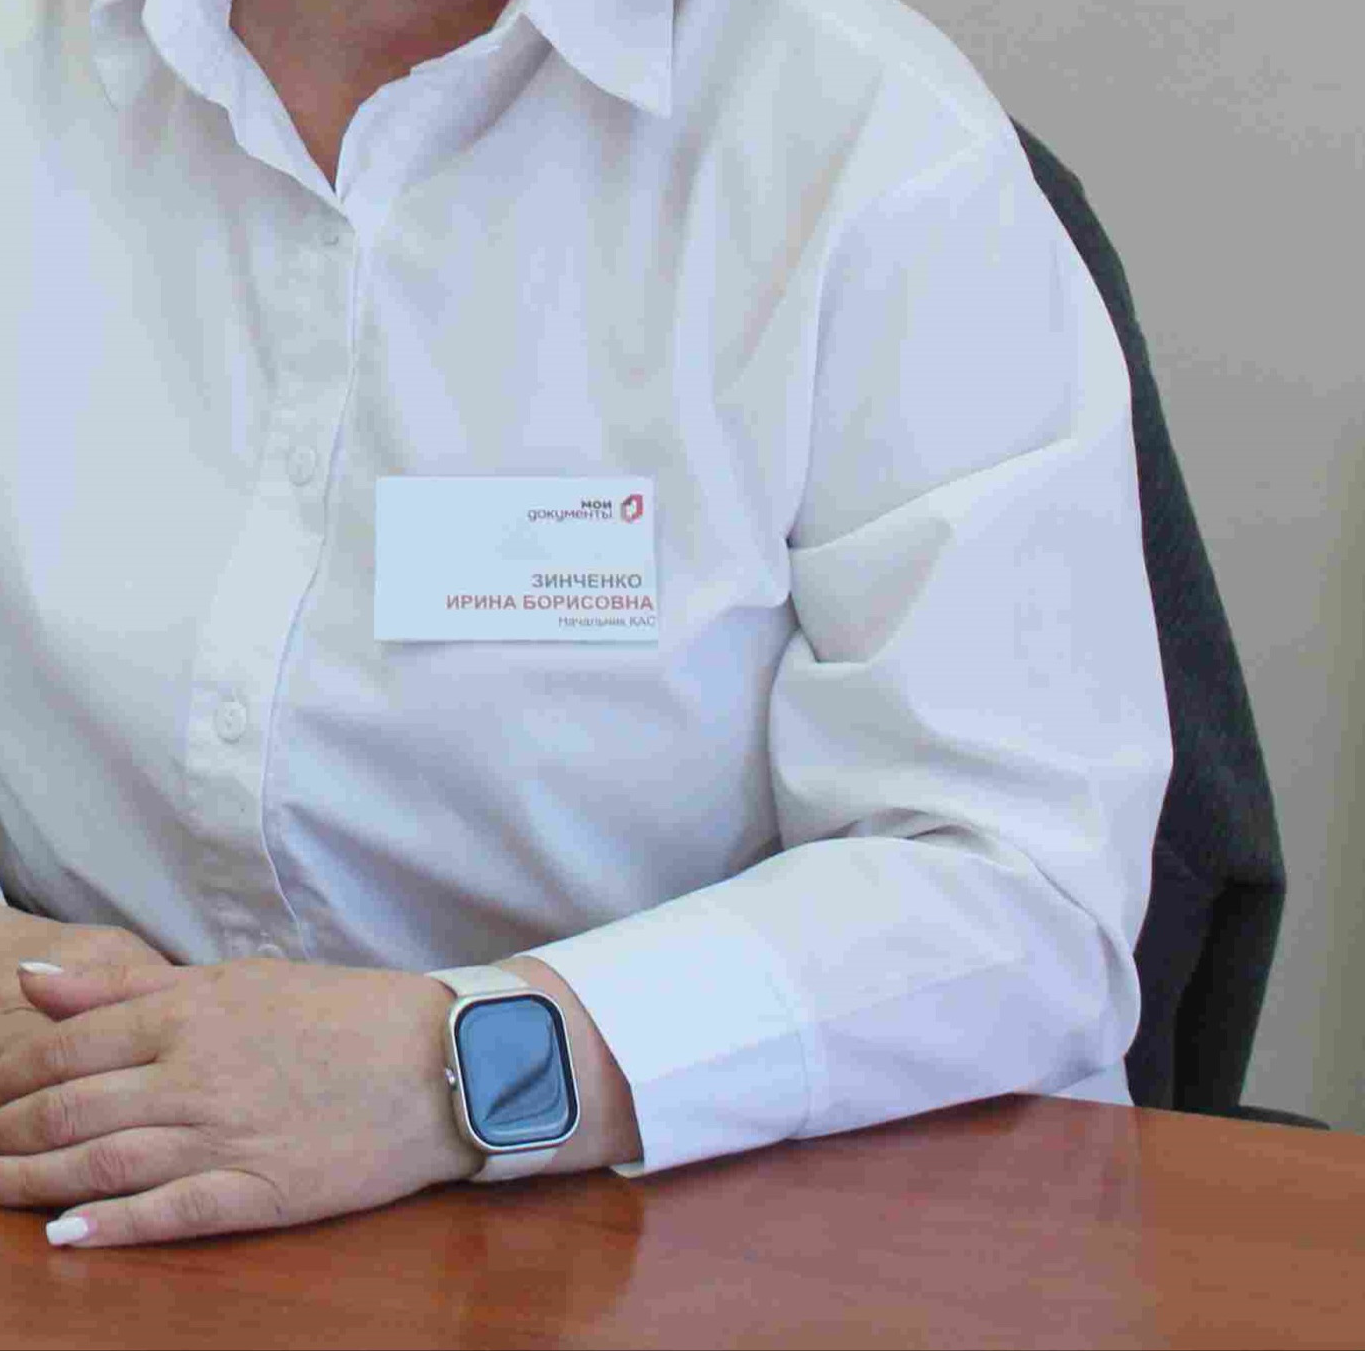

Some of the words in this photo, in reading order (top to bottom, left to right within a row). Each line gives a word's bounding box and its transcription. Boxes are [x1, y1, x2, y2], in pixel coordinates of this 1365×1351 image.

[527, 508, 613, 522] документы
[531, 574, 642, 589] ЗИНЧЕНКО
[446, 594, 517, 611] ИРИНА
[522, 594, 654, 611] БОРИСОВНА
